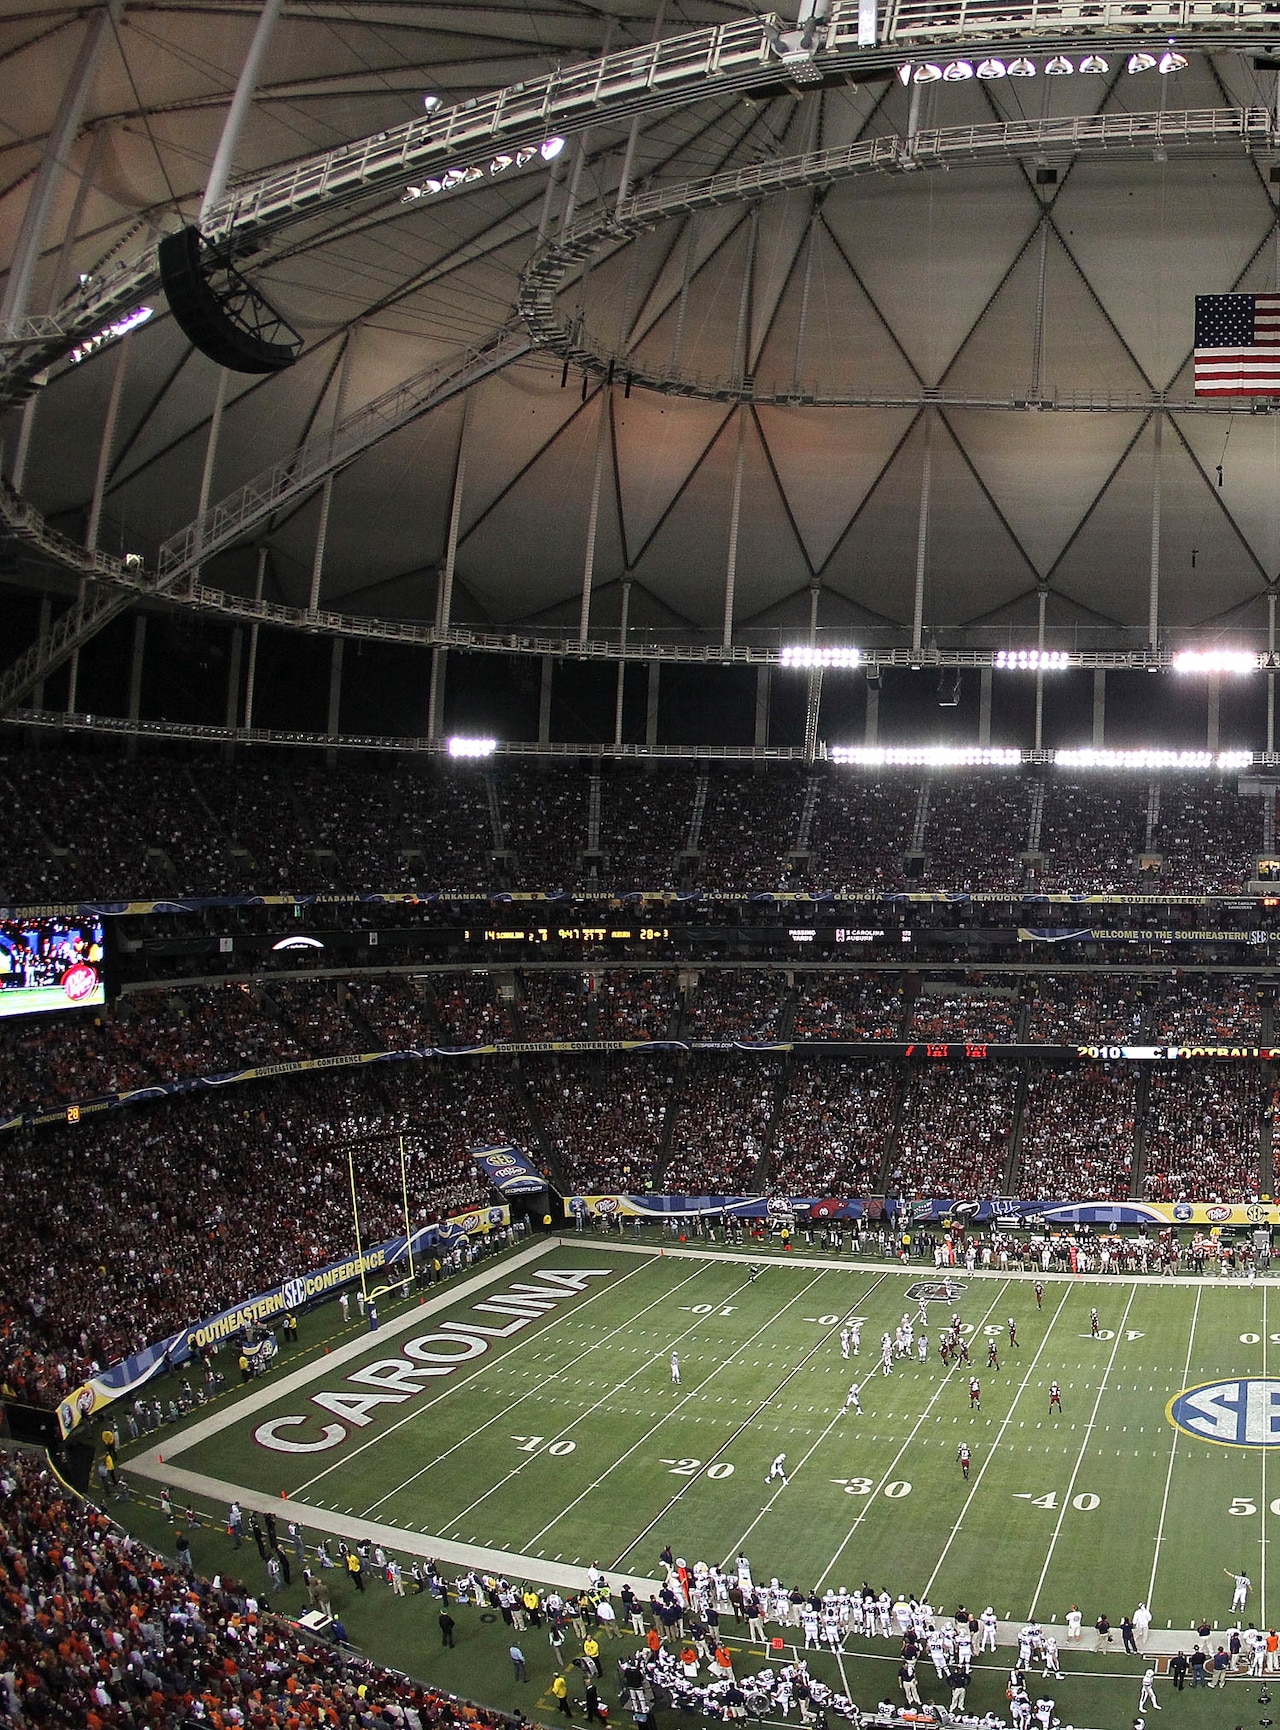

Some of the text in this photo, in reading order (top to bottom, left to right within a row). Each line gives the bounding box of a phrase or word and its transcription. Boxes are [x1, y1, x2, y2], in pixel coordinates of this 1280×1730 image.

[15, 905, 78, 918] CONFERENCE
[484, 931, 495, 941] 14
[640, 929, 654, 940] 28
[1090, 931, 1139, 939] WELCOME
[1140, 931, 1153, 939] TO
[1154, 931, 1173, 939] THE
[1174, 931, 1248, 940] SOUTHEASTERN
[1251, 931, 1267, 943] SEC
[496, 1041, 623, 1052] SOUTHEASTERN CONFERENCE
[255, 1055, 362, 1076] SOUTHEASTERN CONFERENCE
[67, 1107, 79, 1121] 28
[489, 1154, 514, 1166] SEC
[505, 1186, 542, 1195] SECSPORTS.COM
[284, 1278, 305, 1307] SEC
[306, 1250, 386, 1296] CONFERENCE
[253, 1268, 613, 1454] CAROLINA
[517, 1435, 577, 1456] 10
[667, 1458, 735, 1480] 20
[843, 1477, 913, 1499] 30
[1031, 1491, 1101, 1511] 40
